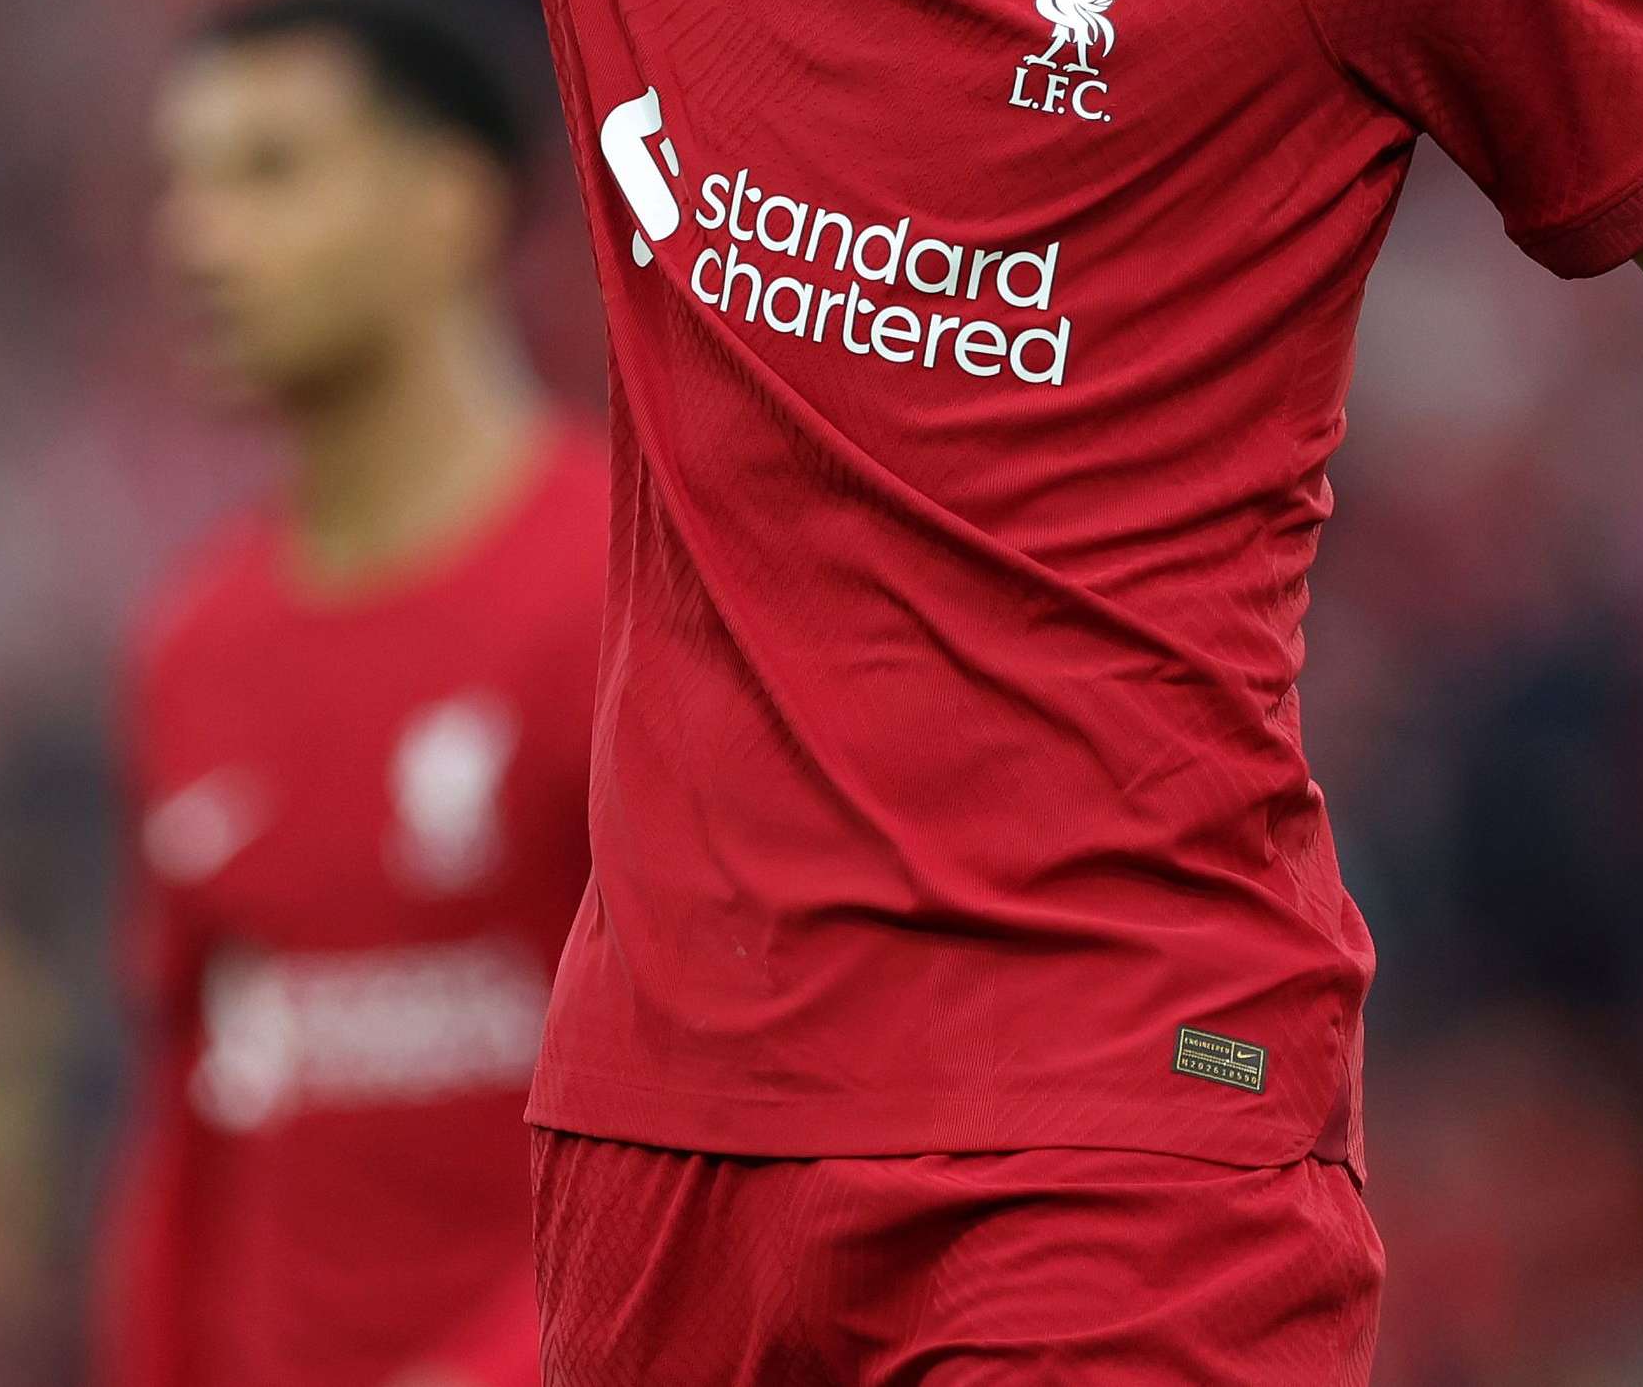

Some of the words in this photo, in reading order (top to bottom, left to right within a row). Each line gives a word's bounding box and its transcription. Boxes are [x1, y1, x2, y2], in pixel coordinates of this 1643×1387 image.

[1008, 66, 1112, 122] L.F.C.
[695, 168, 1060, 311] standard
[690, 242, 1072, 387] chartered
